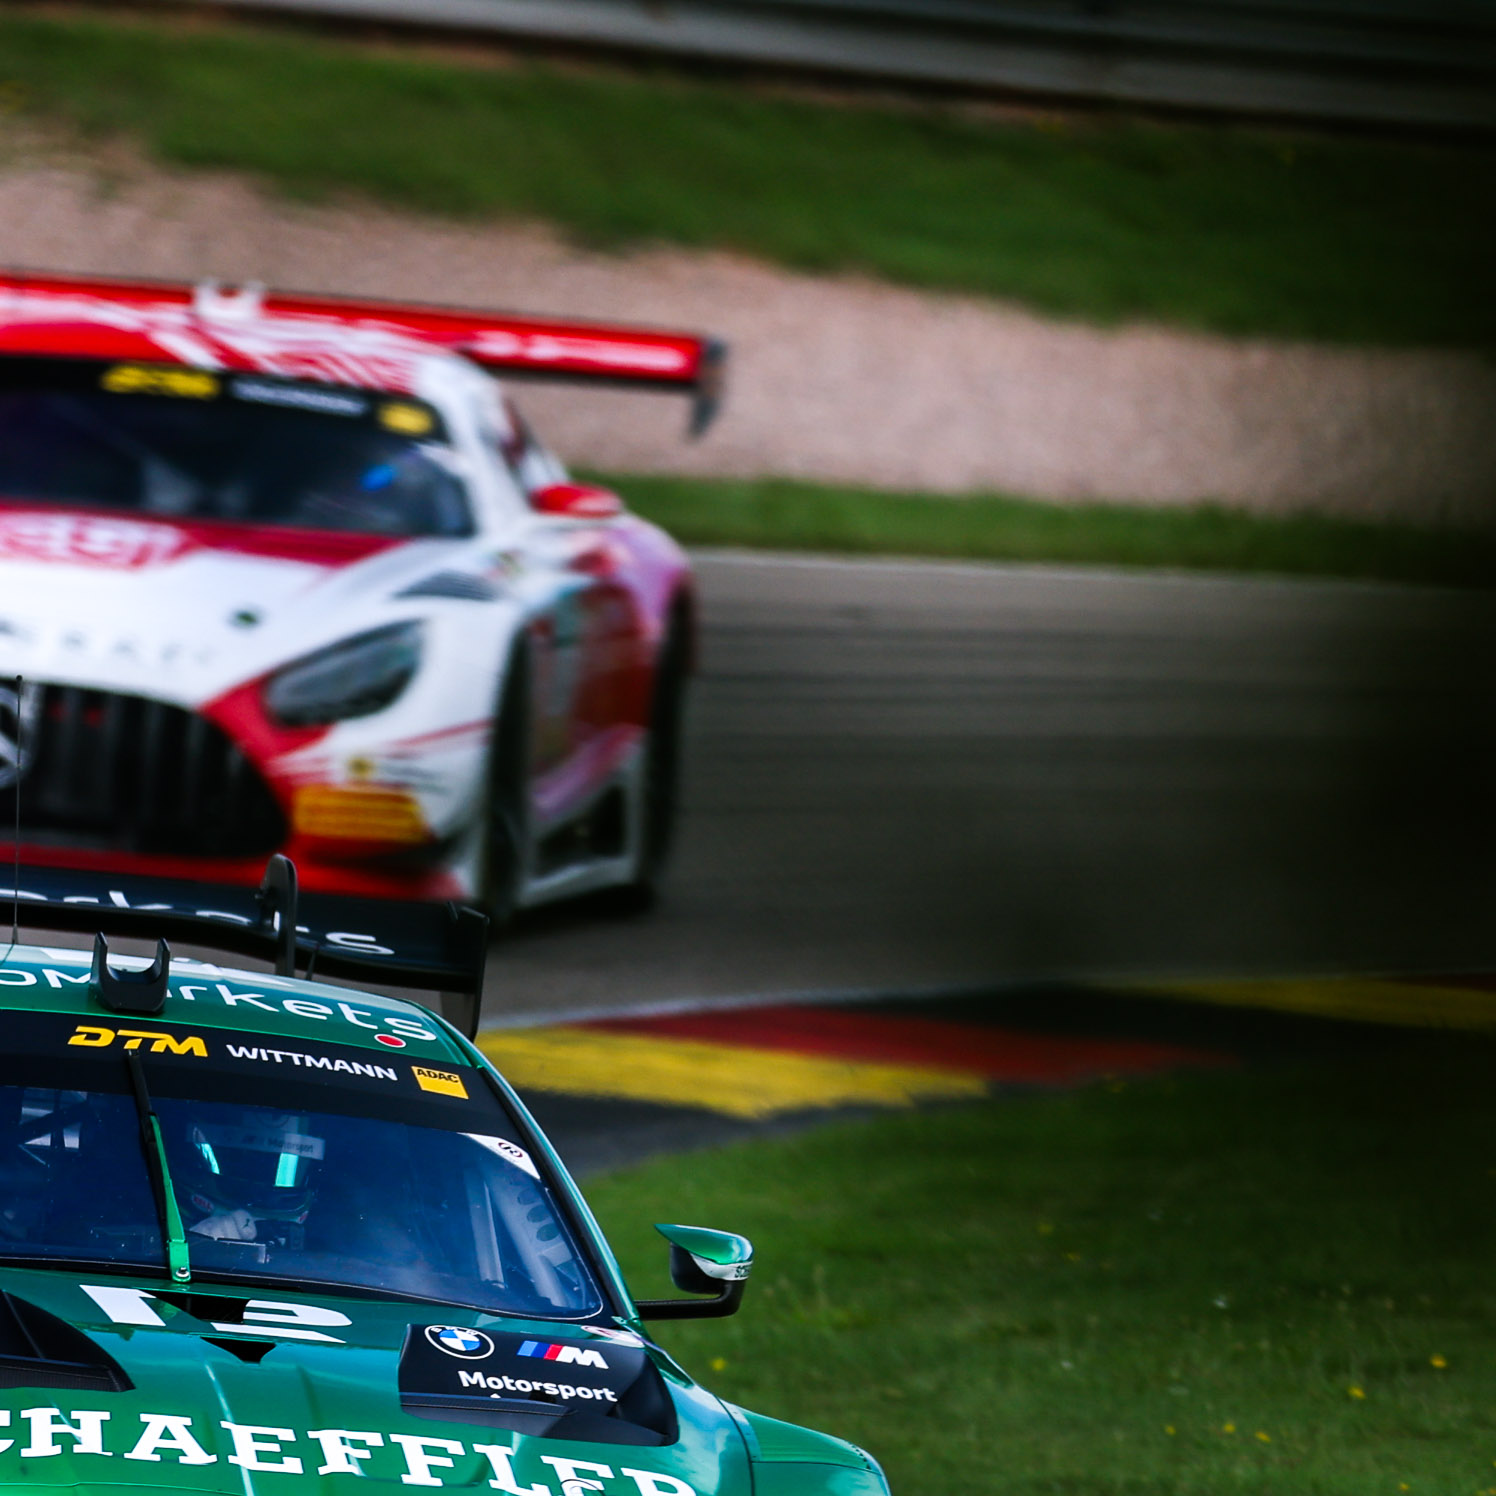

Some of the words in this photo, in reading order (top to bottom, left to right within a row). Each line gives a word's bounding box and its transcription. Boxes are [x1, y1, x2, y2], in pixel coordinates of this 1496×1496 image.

[67, 1025, 209, 1058] DTM
[226, 1043, 398, 1082] WITTMANN
[416, 1068, 459, 1084] ADAC
[457, 1370, 618, 1402] Motorsport
